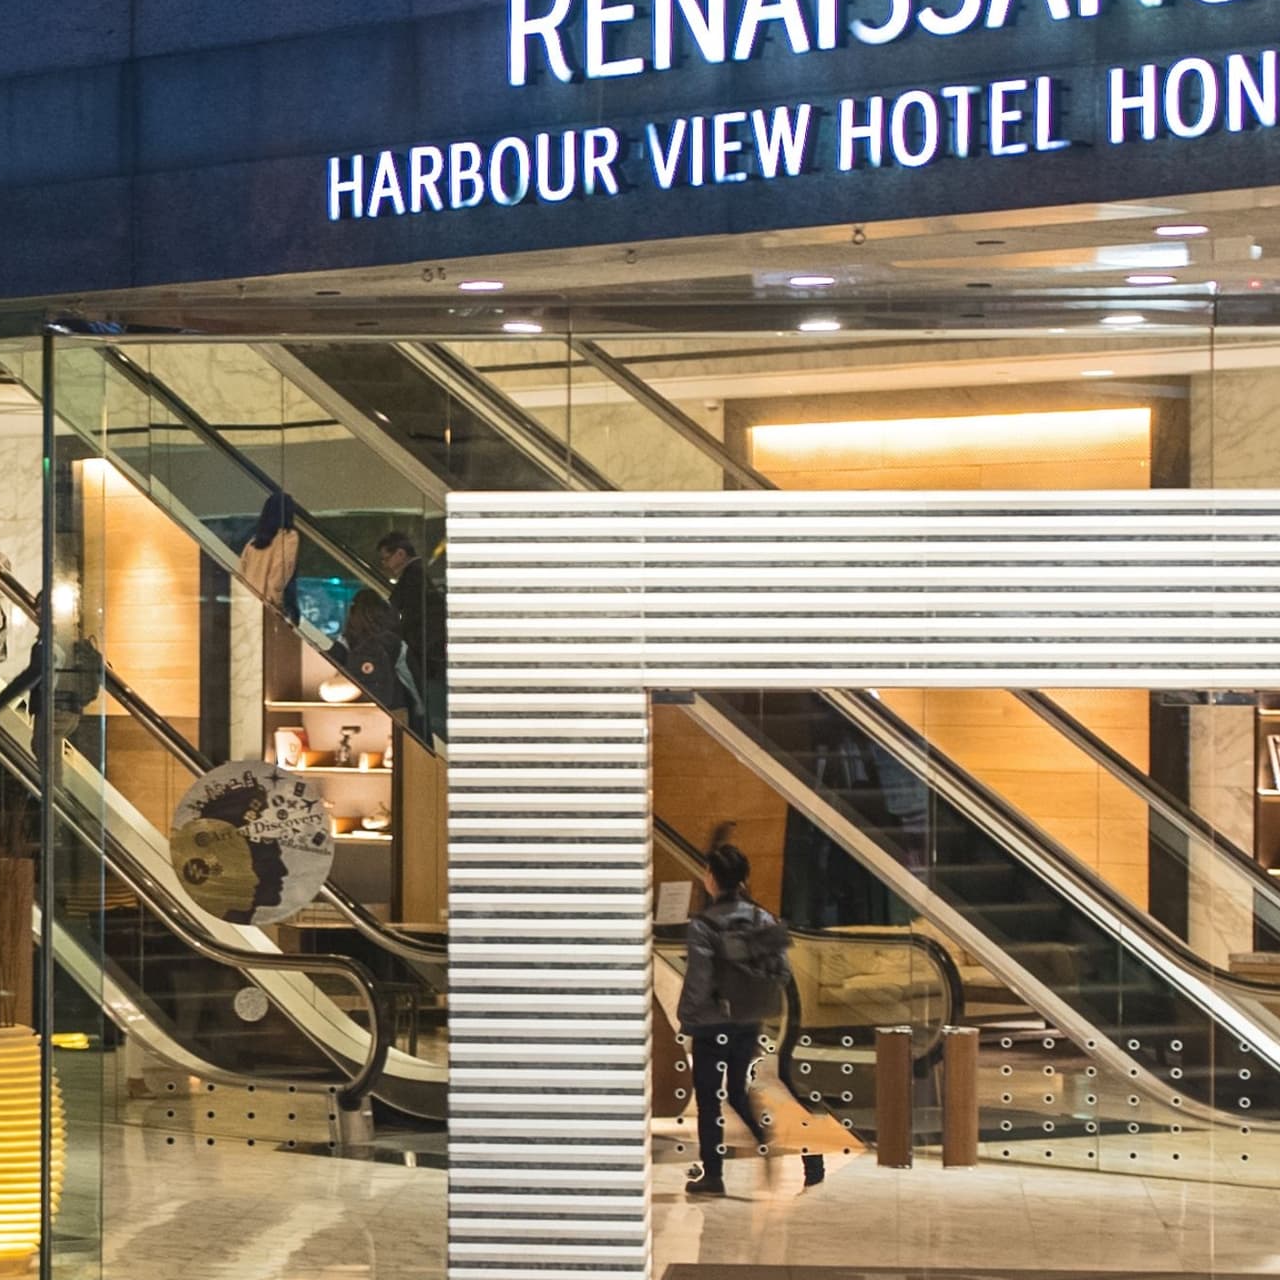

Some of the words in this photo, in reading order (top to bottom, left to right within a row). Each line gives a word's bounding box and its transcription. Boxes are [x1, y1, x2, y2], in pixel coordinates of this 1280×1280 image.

[328, 127, 619, 221] HARBOUR
[645, 102, 812, 190] VIEW
[838, 76, 1069, 173] HOTEL
